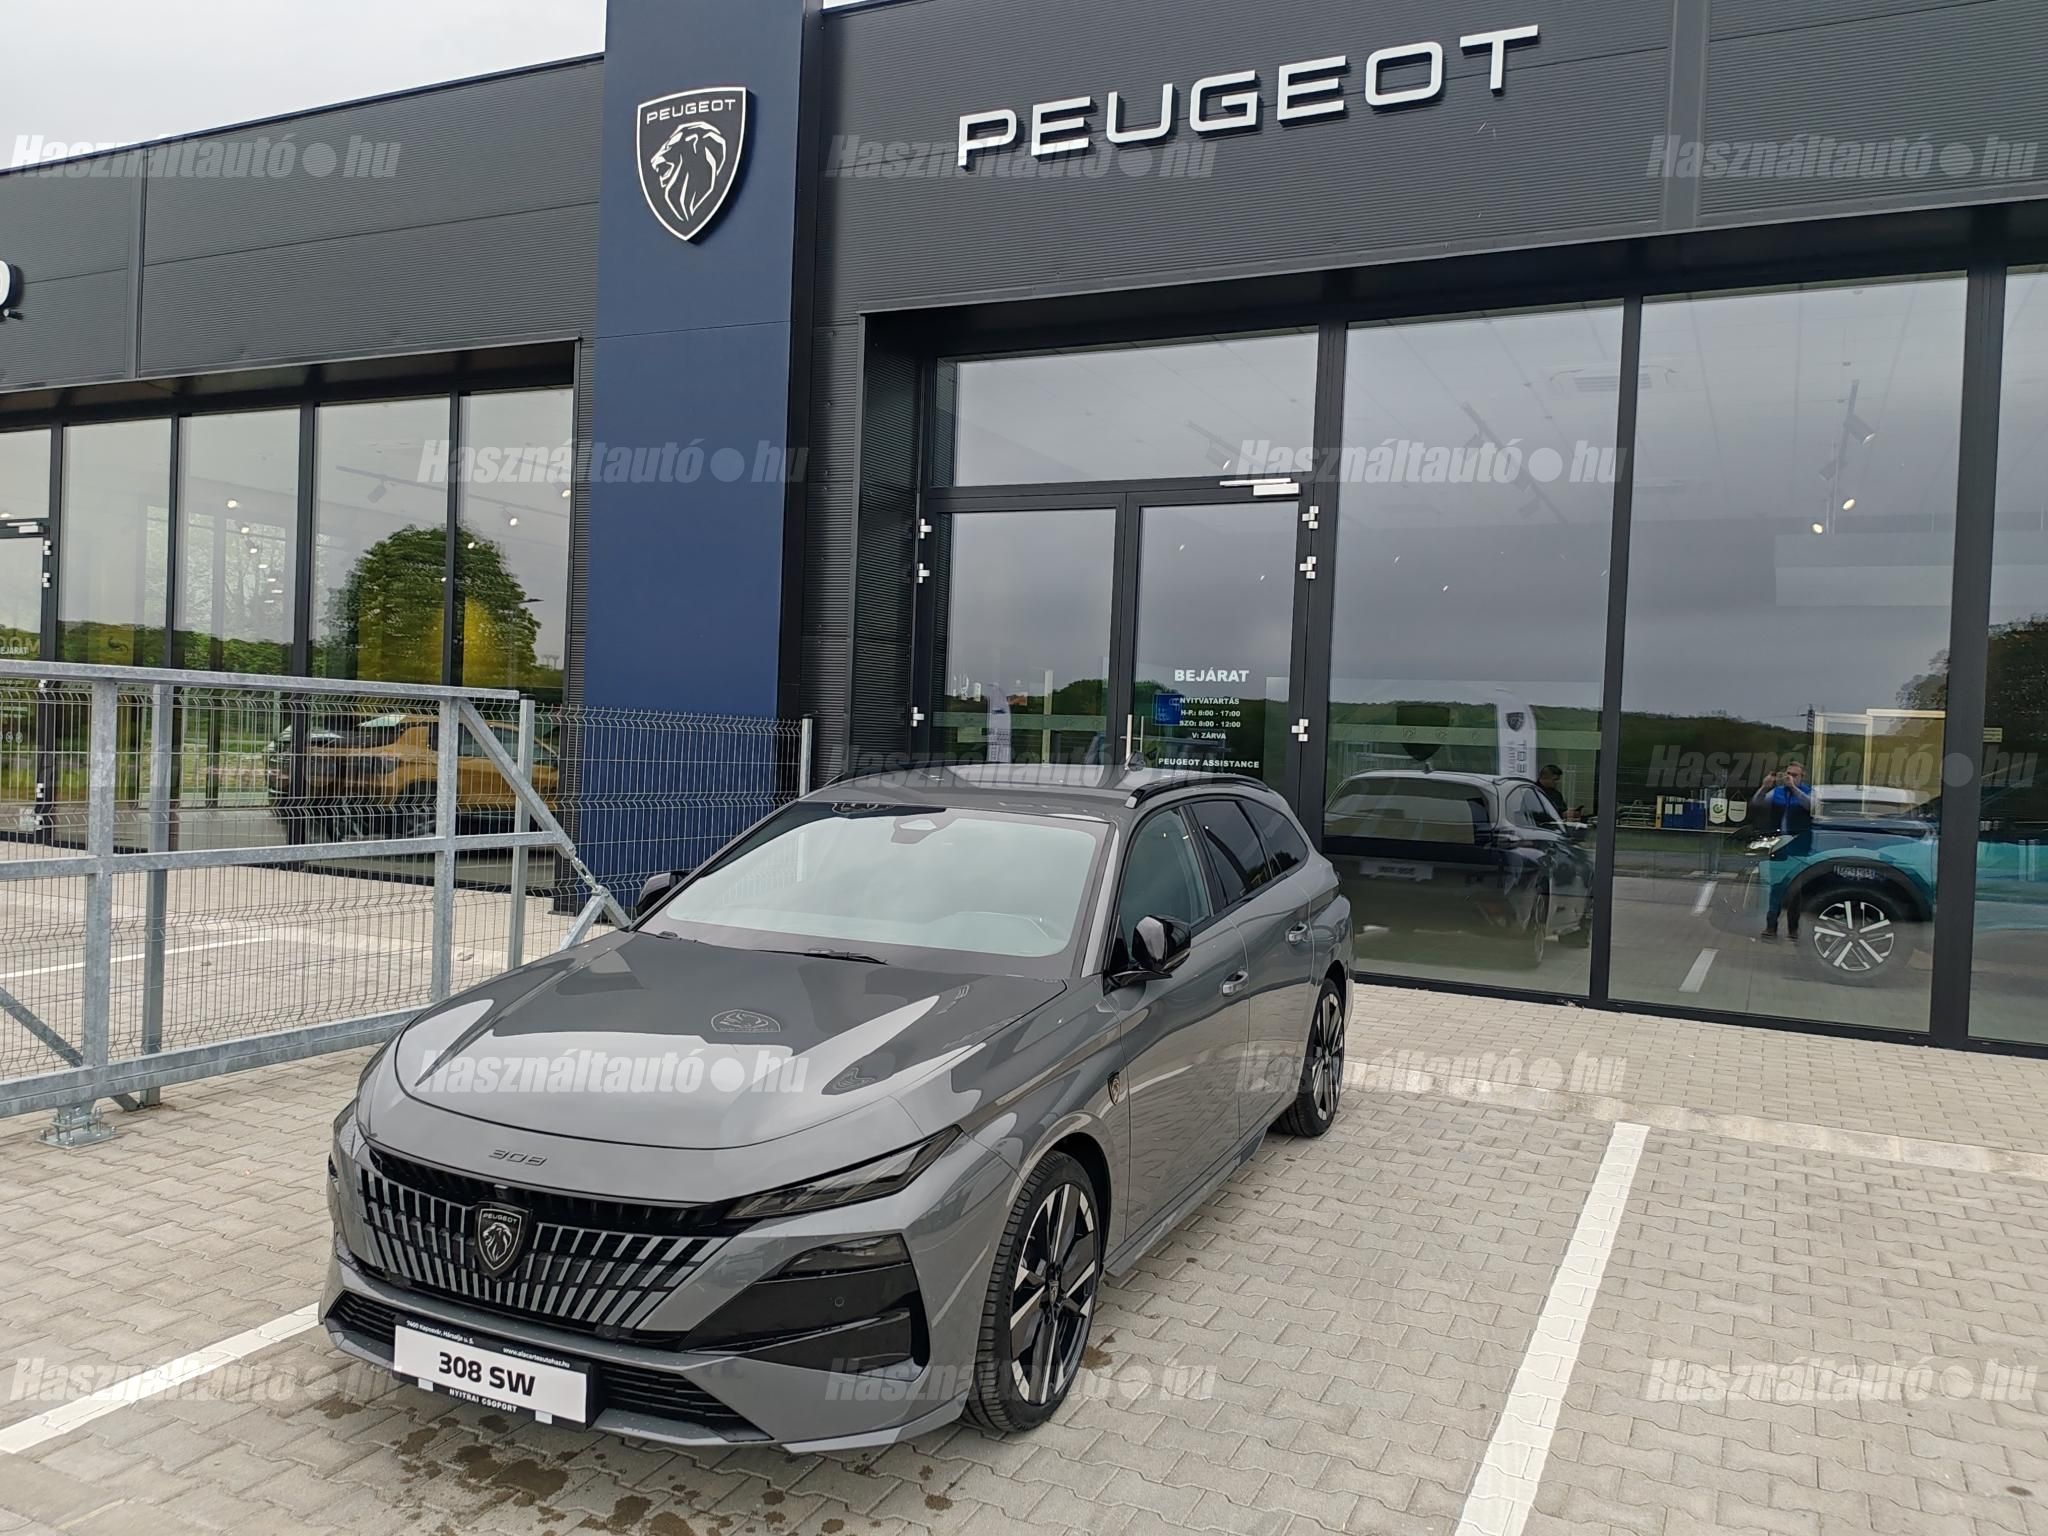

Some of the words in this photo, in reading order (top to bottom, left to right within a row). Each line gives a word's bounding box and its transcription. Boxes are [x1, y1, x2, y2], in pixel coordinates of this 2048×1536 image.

[957, 24, 1539, 167] PEUGEOT
[646, 98, 736, 125] PEUGEOT
[1174, 666, 1250, 682] BEJÁRAT
[1179, 696, 1240, 705] NYITVATARTÁS
[1201, 731, 1227, 740] ZÁRVA
[1158, 758, 1200, 766] PEUGEOT
[1202, 759, 1260, 769] ASSISTANCE
[488, 1149, 548, 1167] 308
[482, 1212, 518, 1224] PEUGEOT
[438, 1351, 482, 1384] 308
[489, 1365, 536, 1397] SW
[449, 1388, 480, 1403] NYITRAI
[481, 1398, 518, 1413] CSOPORT
